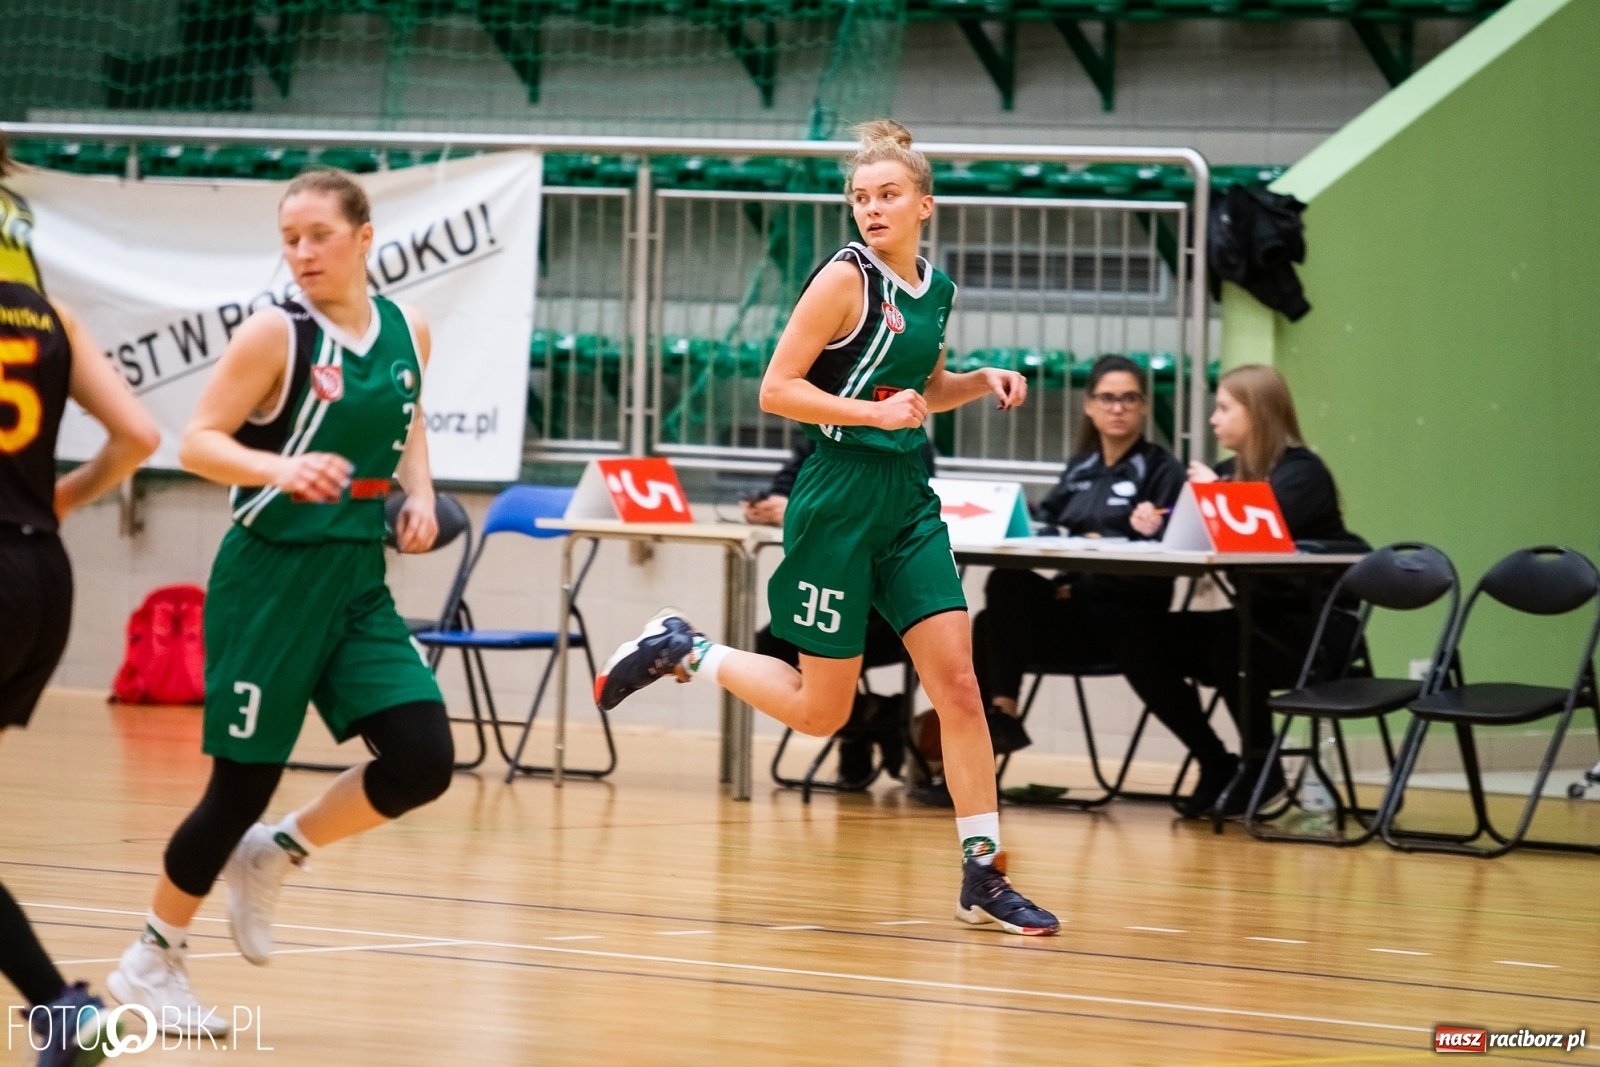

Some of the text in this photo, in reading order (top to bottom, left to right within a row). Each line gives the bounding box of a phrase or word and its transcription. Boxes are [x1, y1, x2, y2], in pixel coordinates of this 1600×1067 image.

[105, 331, 160, 387] ST
[169, 313, 209, 364] W
[793, 581, 845, 634] 35
[228, 681, 262, 739] 3
